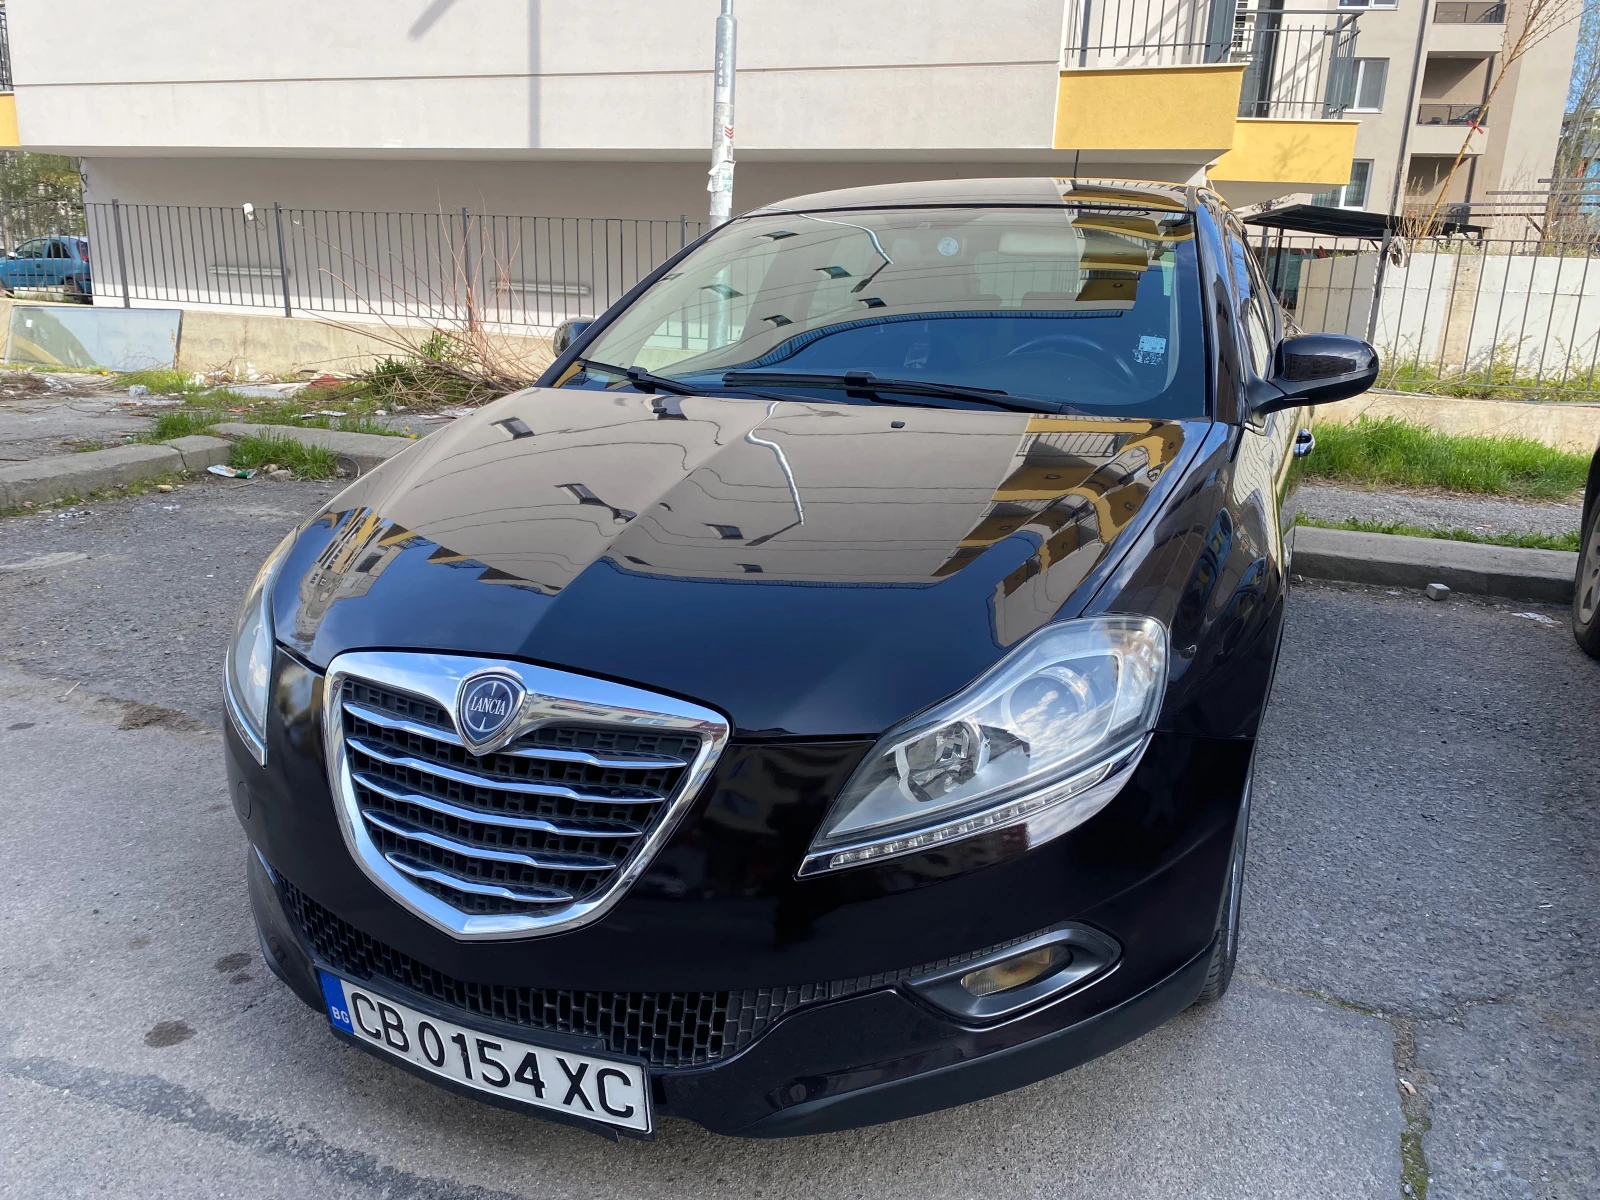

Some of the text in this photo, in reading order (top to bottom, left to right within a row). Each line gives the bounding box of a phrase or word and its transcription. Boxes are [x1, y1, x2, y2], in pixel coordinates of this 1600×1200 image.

[470, 696, 506, 716] LANCIA
[331, 1005, 350, 1024] BG
[351, 992, 634, 1118] CB 0154 XC
